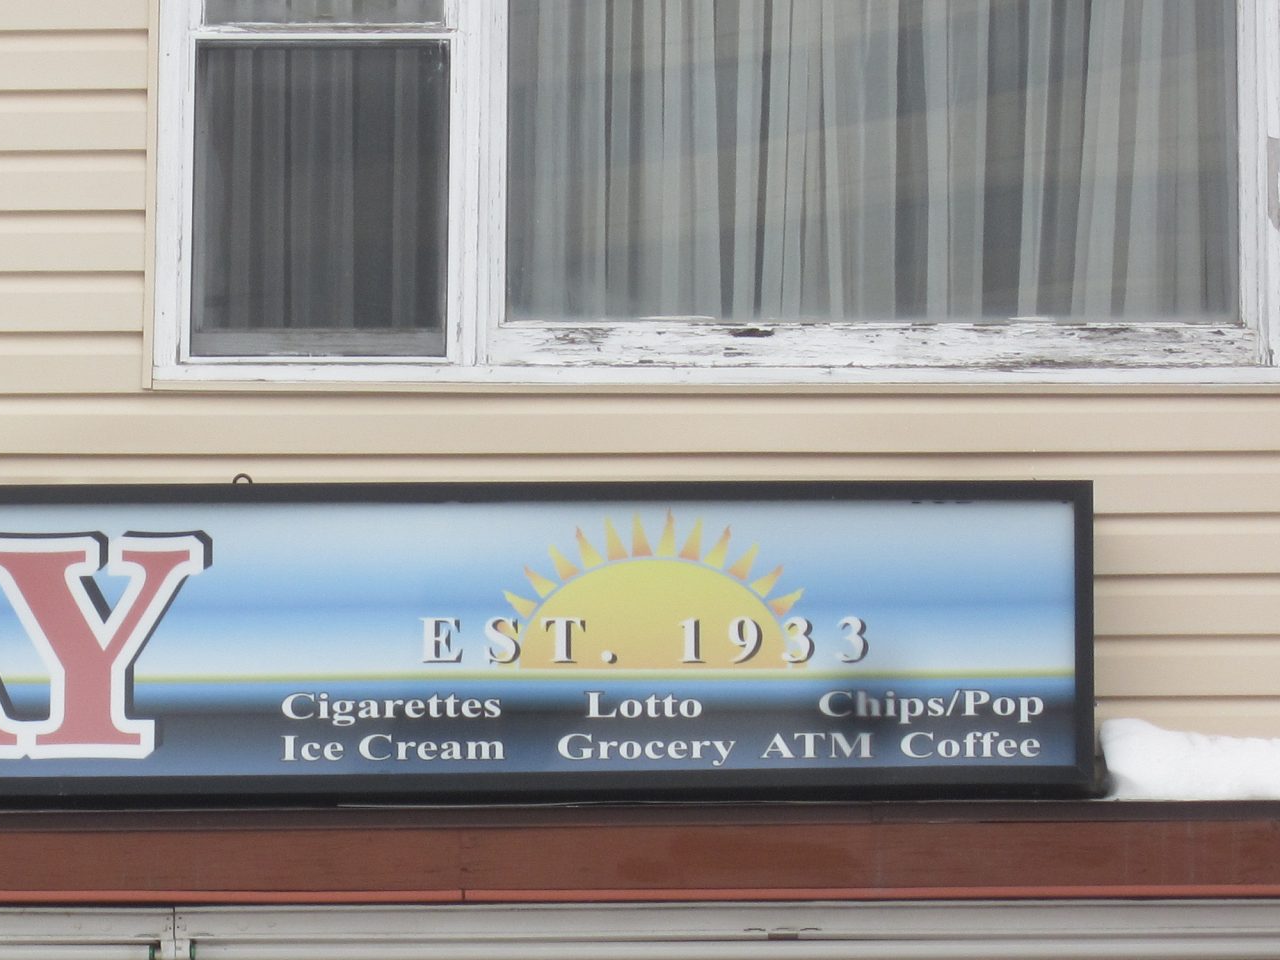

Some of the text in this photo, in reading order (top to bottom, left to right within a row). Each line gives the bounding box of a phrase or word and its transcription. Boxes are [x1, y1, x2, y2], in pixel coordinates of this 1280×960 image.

[420, 614, 871, 665] EST. 1933
[281, 692, 502, 726] Cigarettes
[585, 692, 703, 719] Lotto
[819, 690, 1045, 723] Chips/Pop
[281, 734, 506, 762] Ice Cream
[558, 733, 736, 767] Grocery
[761, 732, 873, 759] ATM
[900, 731, 1041, 759] Coffee
